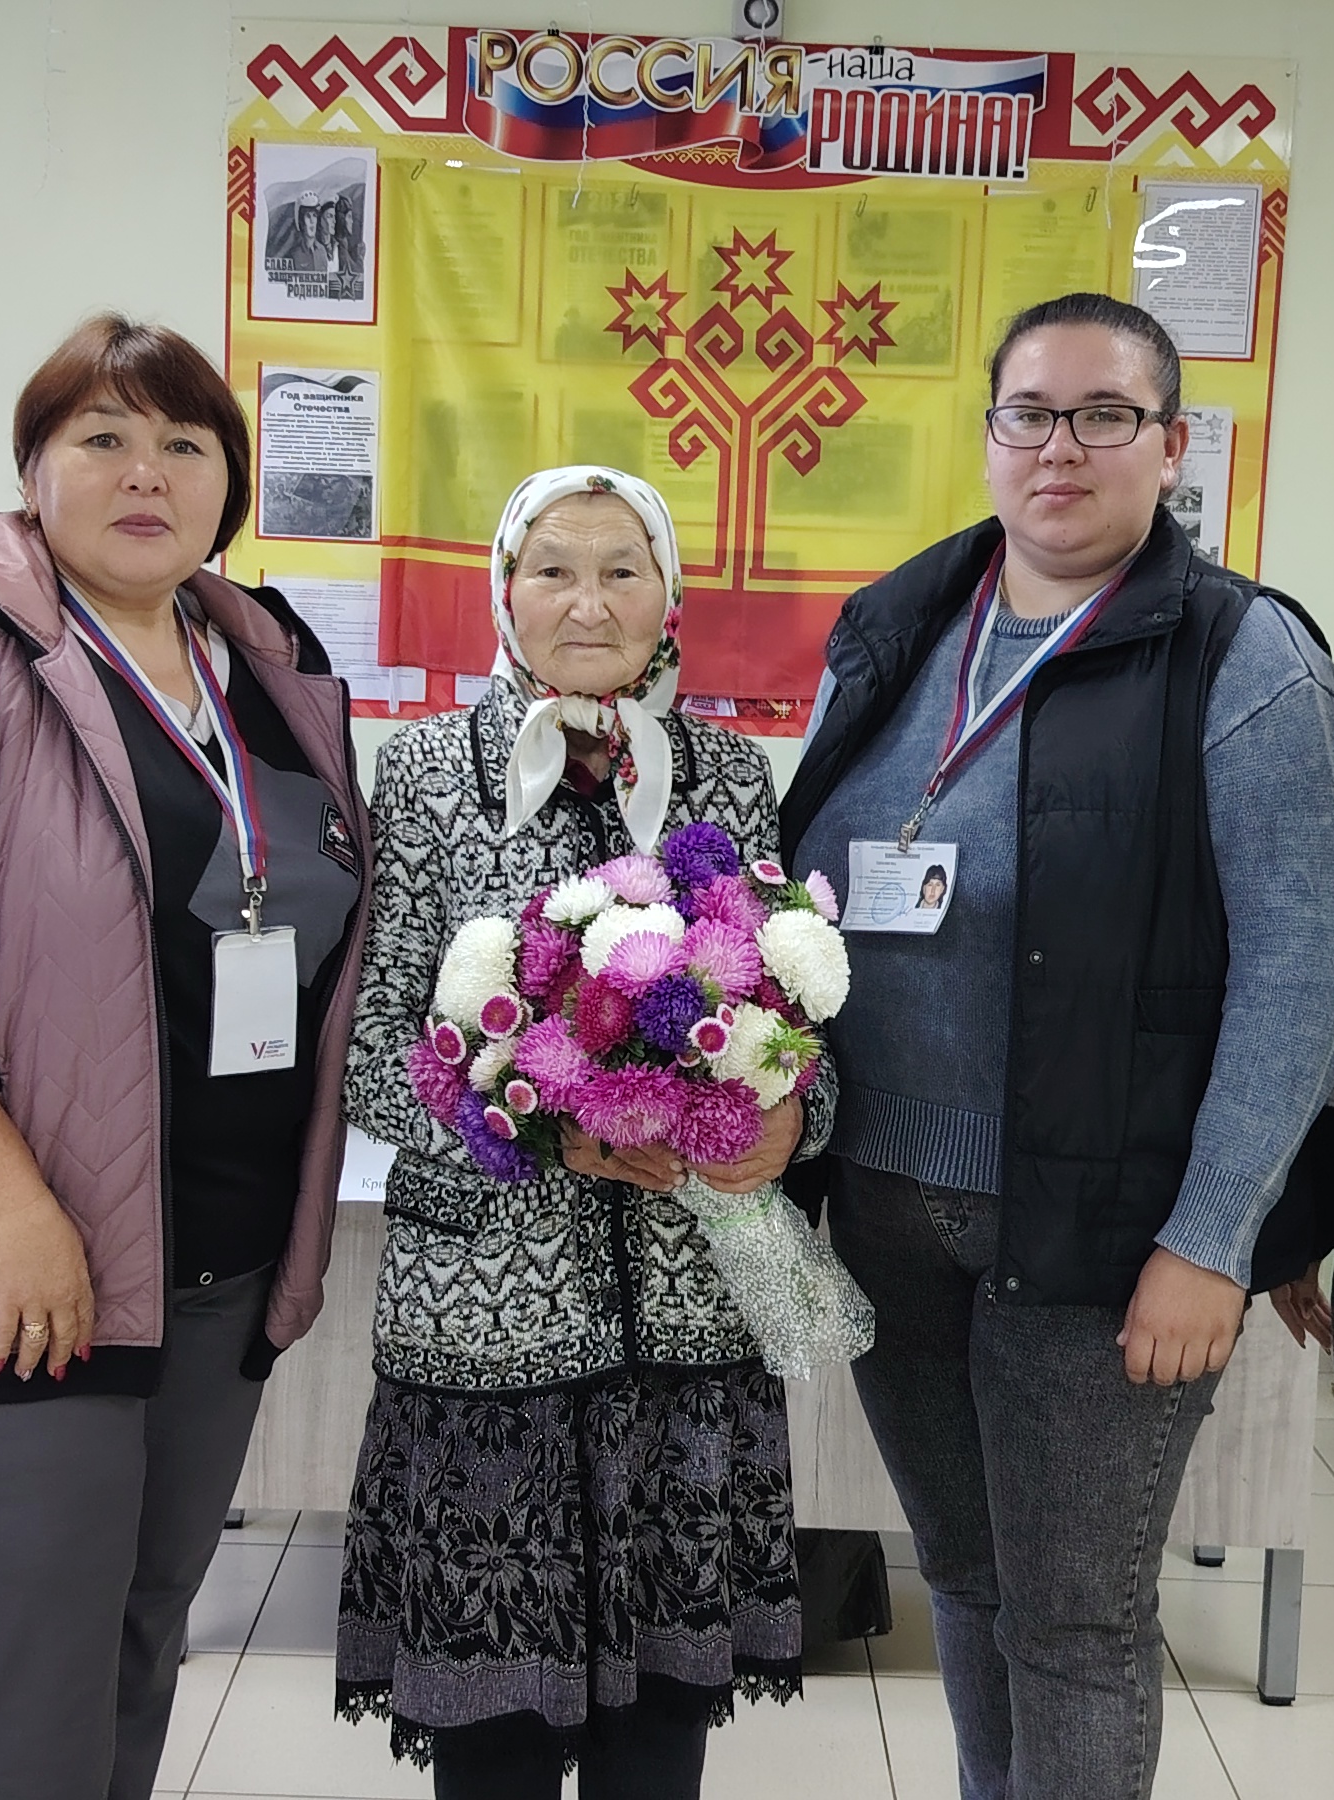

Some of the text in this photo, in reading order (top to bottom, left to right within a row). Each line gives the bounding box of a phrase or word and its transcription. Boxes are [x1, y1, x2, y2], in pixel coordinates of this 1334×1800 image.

[478, 31, 803, 115] РОССИЯ
[810, 89, 1033, 179] РОДИНА!
[265, 259, 294, 271] СЛАВА
[287, 284, 328, 300] РОДИНЫ
[280, 391, 364, 402] Год защитника
[294, 403, 350, 413] Отечества
